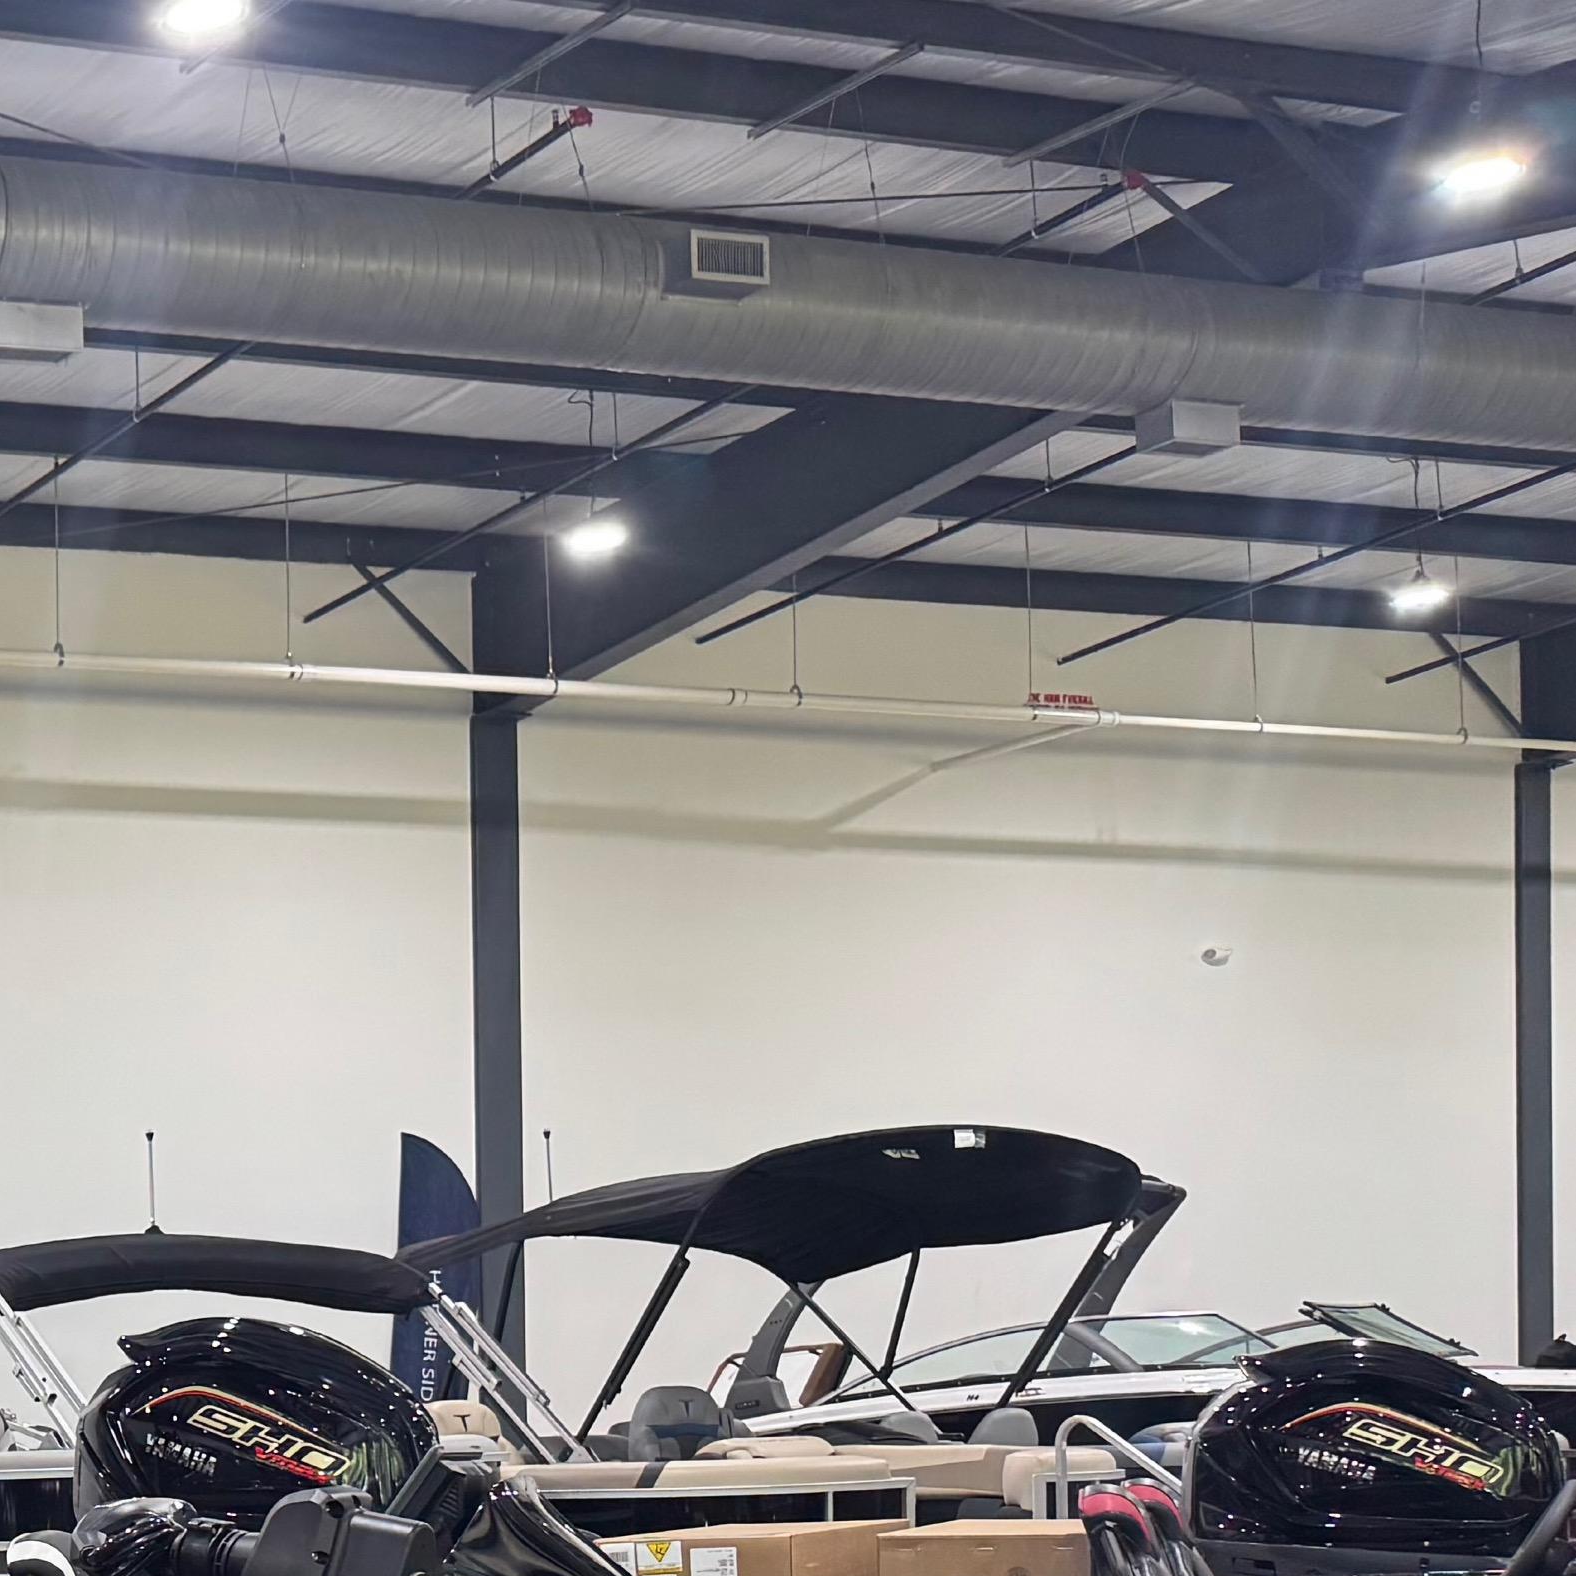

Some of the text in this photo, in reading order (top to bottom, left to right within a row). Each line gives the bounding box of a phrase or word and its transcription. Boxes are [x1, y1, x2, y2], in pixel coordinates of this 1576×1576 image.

[186, 1404, 351, 1477] SHO
[1297, 1446, 1377, 1482] YAMAHA
[1342, 1418, 1504, 1484] SHO
